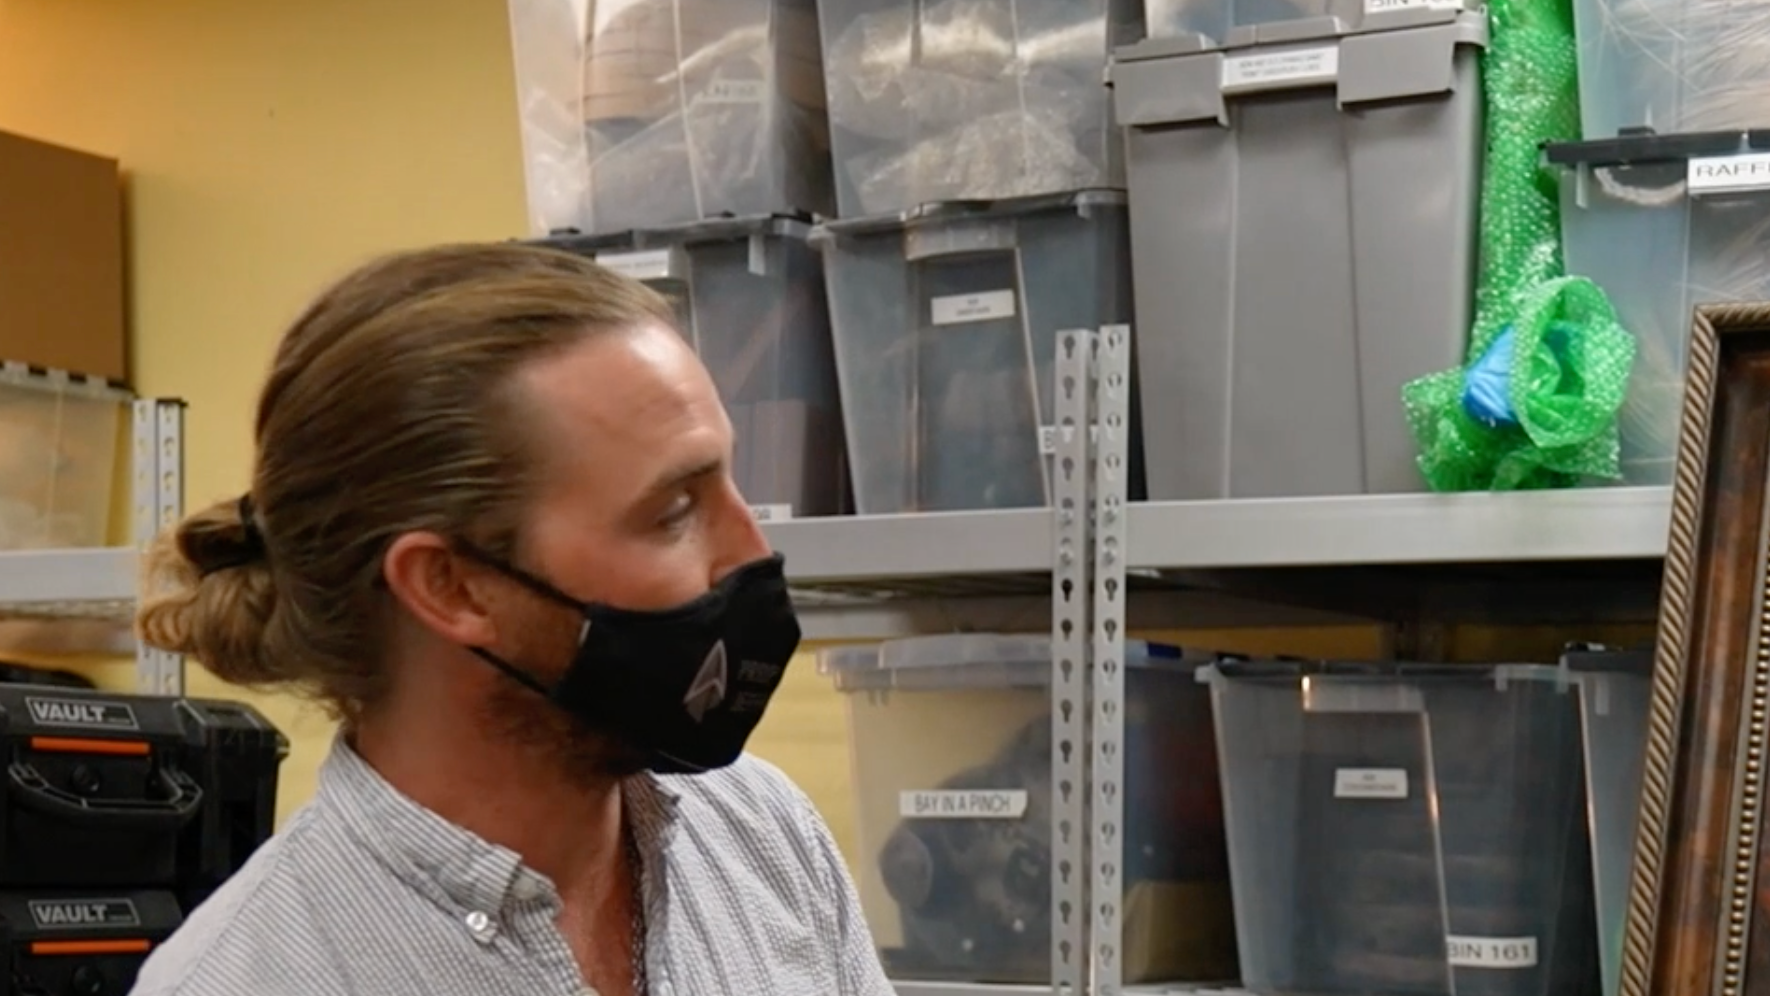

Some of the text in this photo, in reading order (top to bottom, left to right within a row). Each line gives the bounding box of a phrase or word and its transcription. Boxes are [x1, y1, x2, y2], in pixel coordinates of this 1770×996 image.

[33, 701, 106, 723] VAULT
[35, 904, 107, 923] VAULT
[1447, 942, 1530, 961] BIN 161
